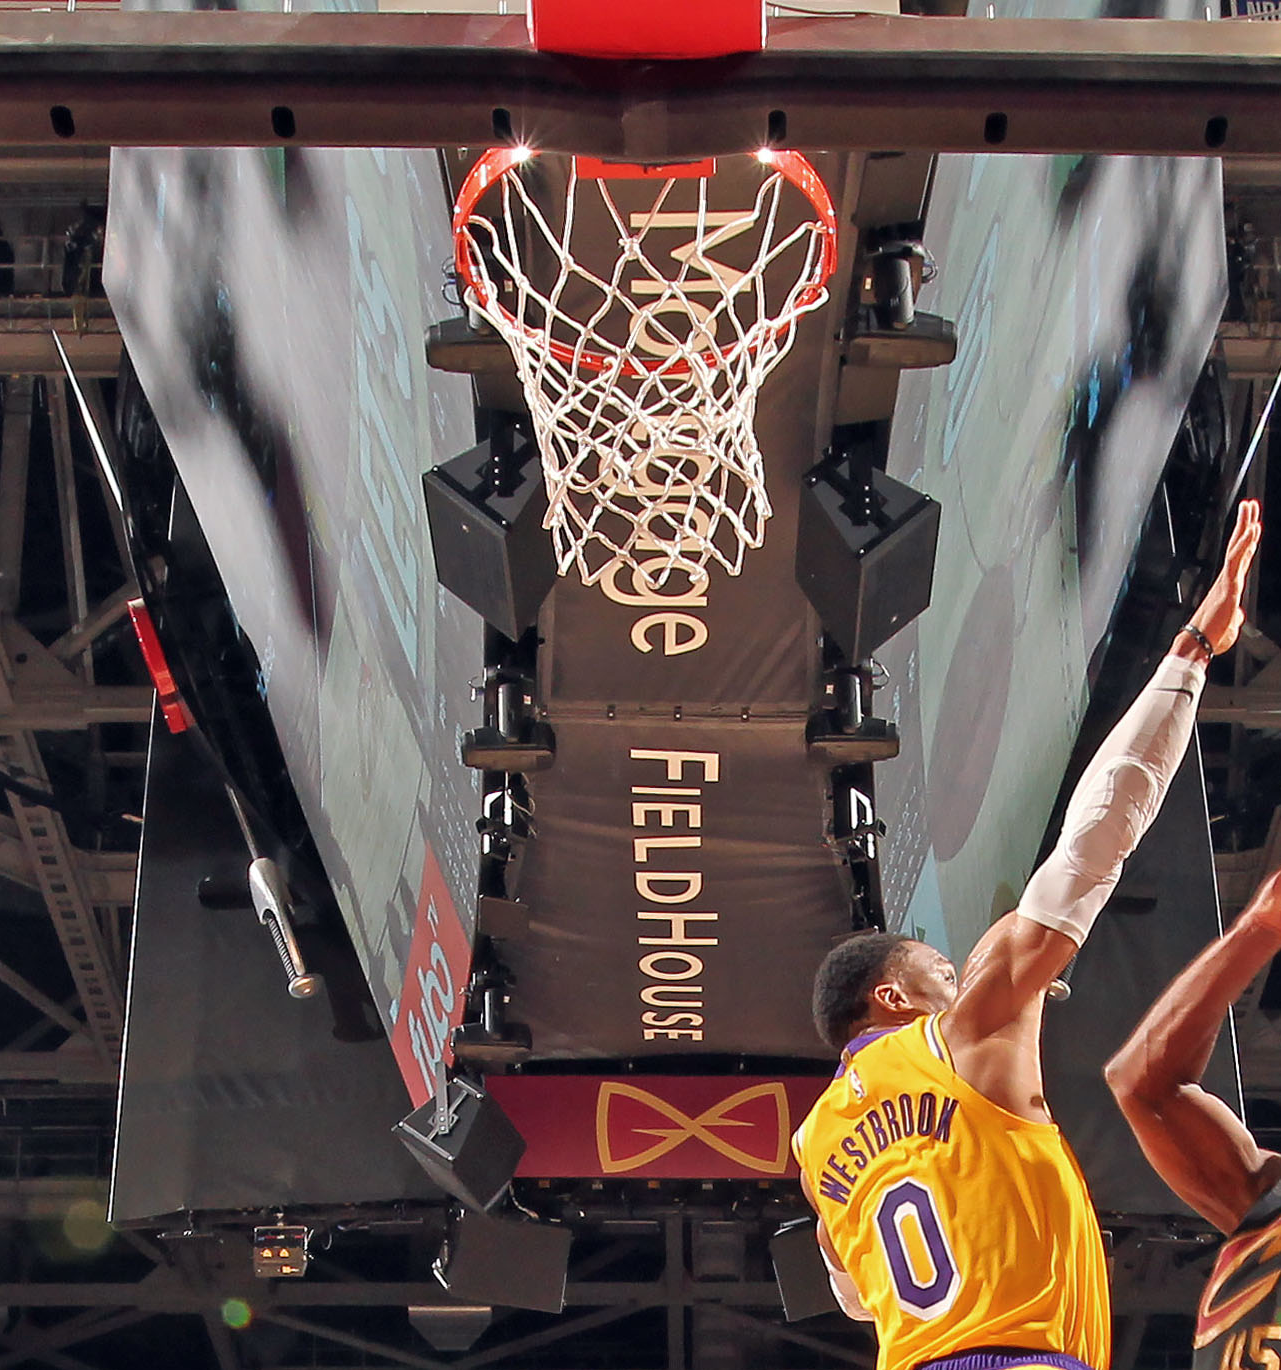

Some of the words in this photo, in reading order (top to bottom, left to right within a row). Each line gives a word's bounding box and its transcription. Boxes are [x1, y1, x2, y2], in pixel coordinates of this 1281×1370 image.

[630, 749, 719, 1041] FIELDHOUSE
[819, 1092, 959, 1205] WESTBROOK
[876, 1179, 959, 1317] 0
